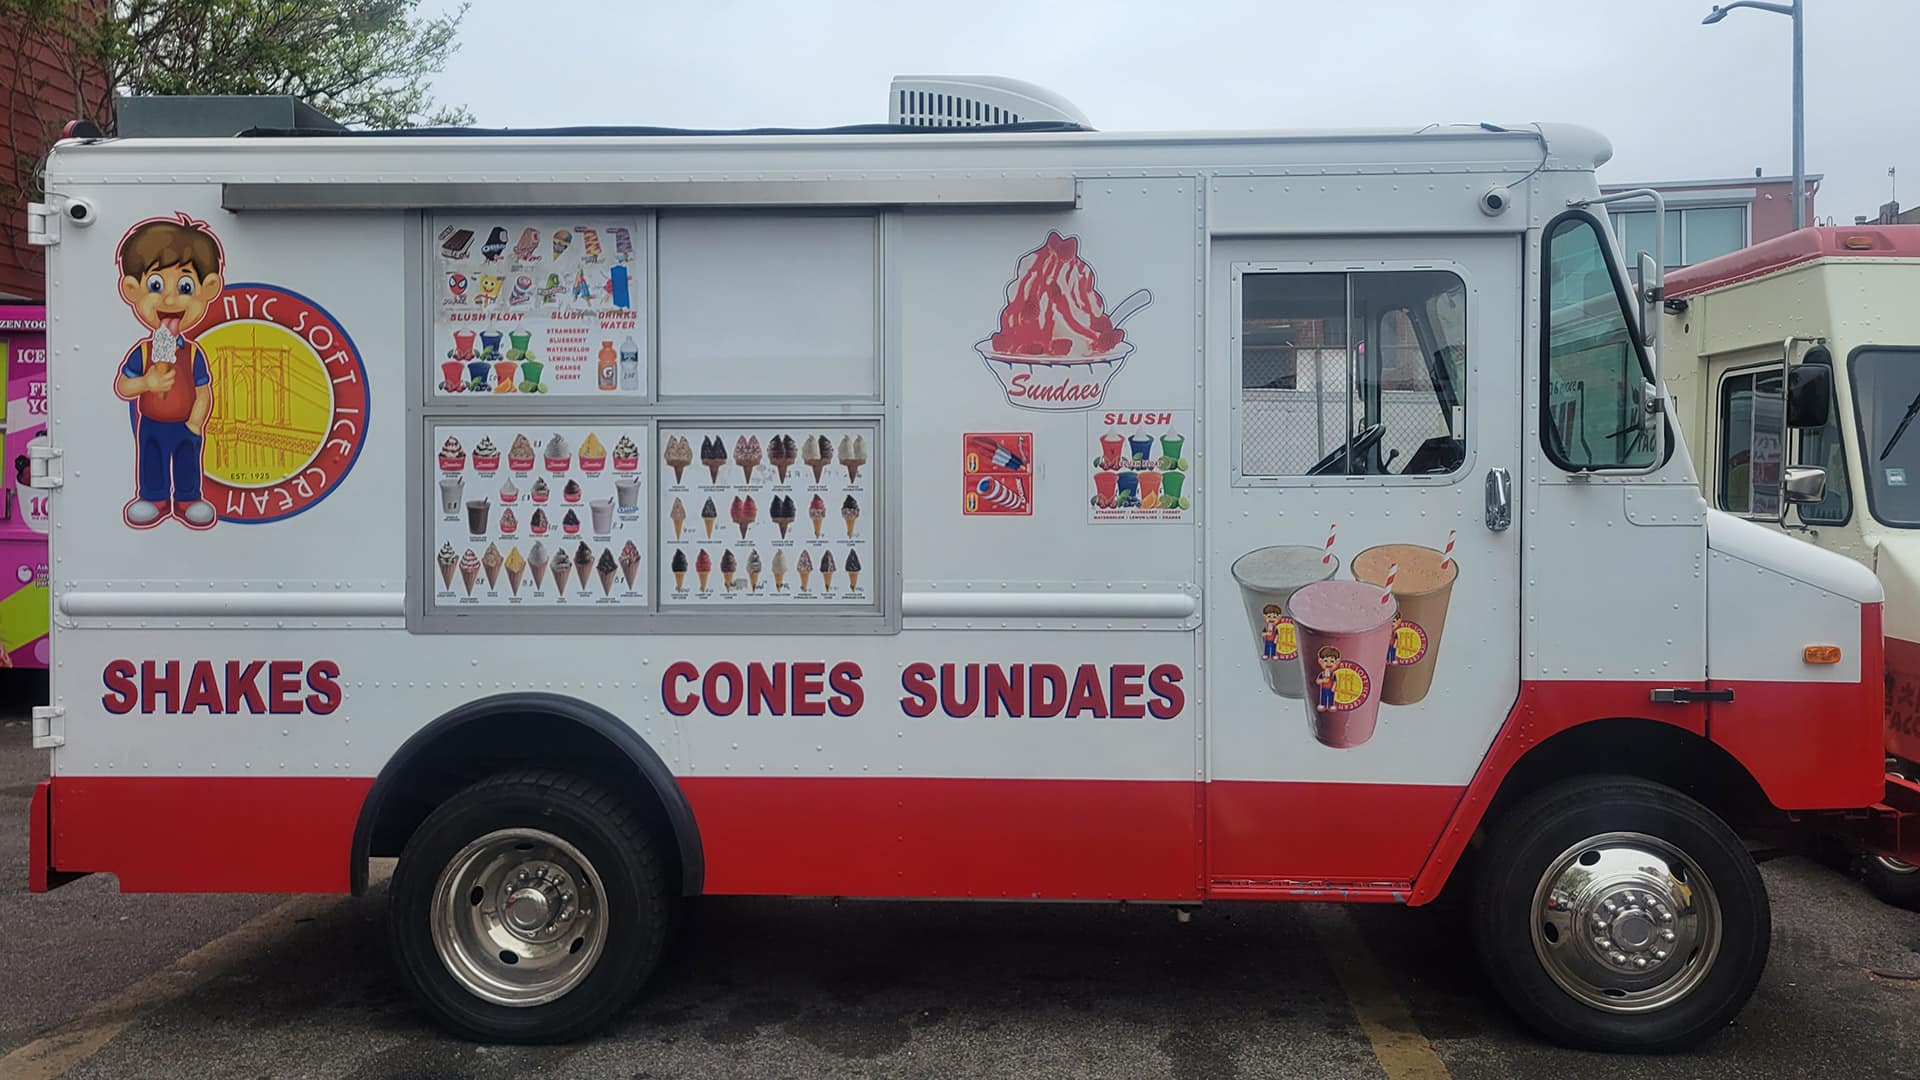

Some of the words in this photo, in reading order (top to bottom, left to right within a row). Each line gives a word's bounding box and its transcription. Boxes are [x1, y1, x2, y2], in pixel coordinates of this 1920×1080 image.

[223, 294, 278, 321] NYC
[450, 313, 486, 321] SLUSH
[490, 313, 524, 321] FLOAT
[552, 311, 586, 320] SLUSH
[598, 311, 638, 320] DRINKS
[600, 321, 636, 329] WATER
[17, 349, 46, 363] ICE
[292, 311, 357, 384] SOFT
[1008, 373, 1101, 402] Sundaes
[325, 408, 359, 457] ICE
[1103, 412, 1172, 425] SLUSH
[226, 467, 327, 516] CREAM
[102, 659, 342, 715] SHAKES
[661, 661, 865, 717] CONES
[900, 662, 1185, 720] SUNDAES
